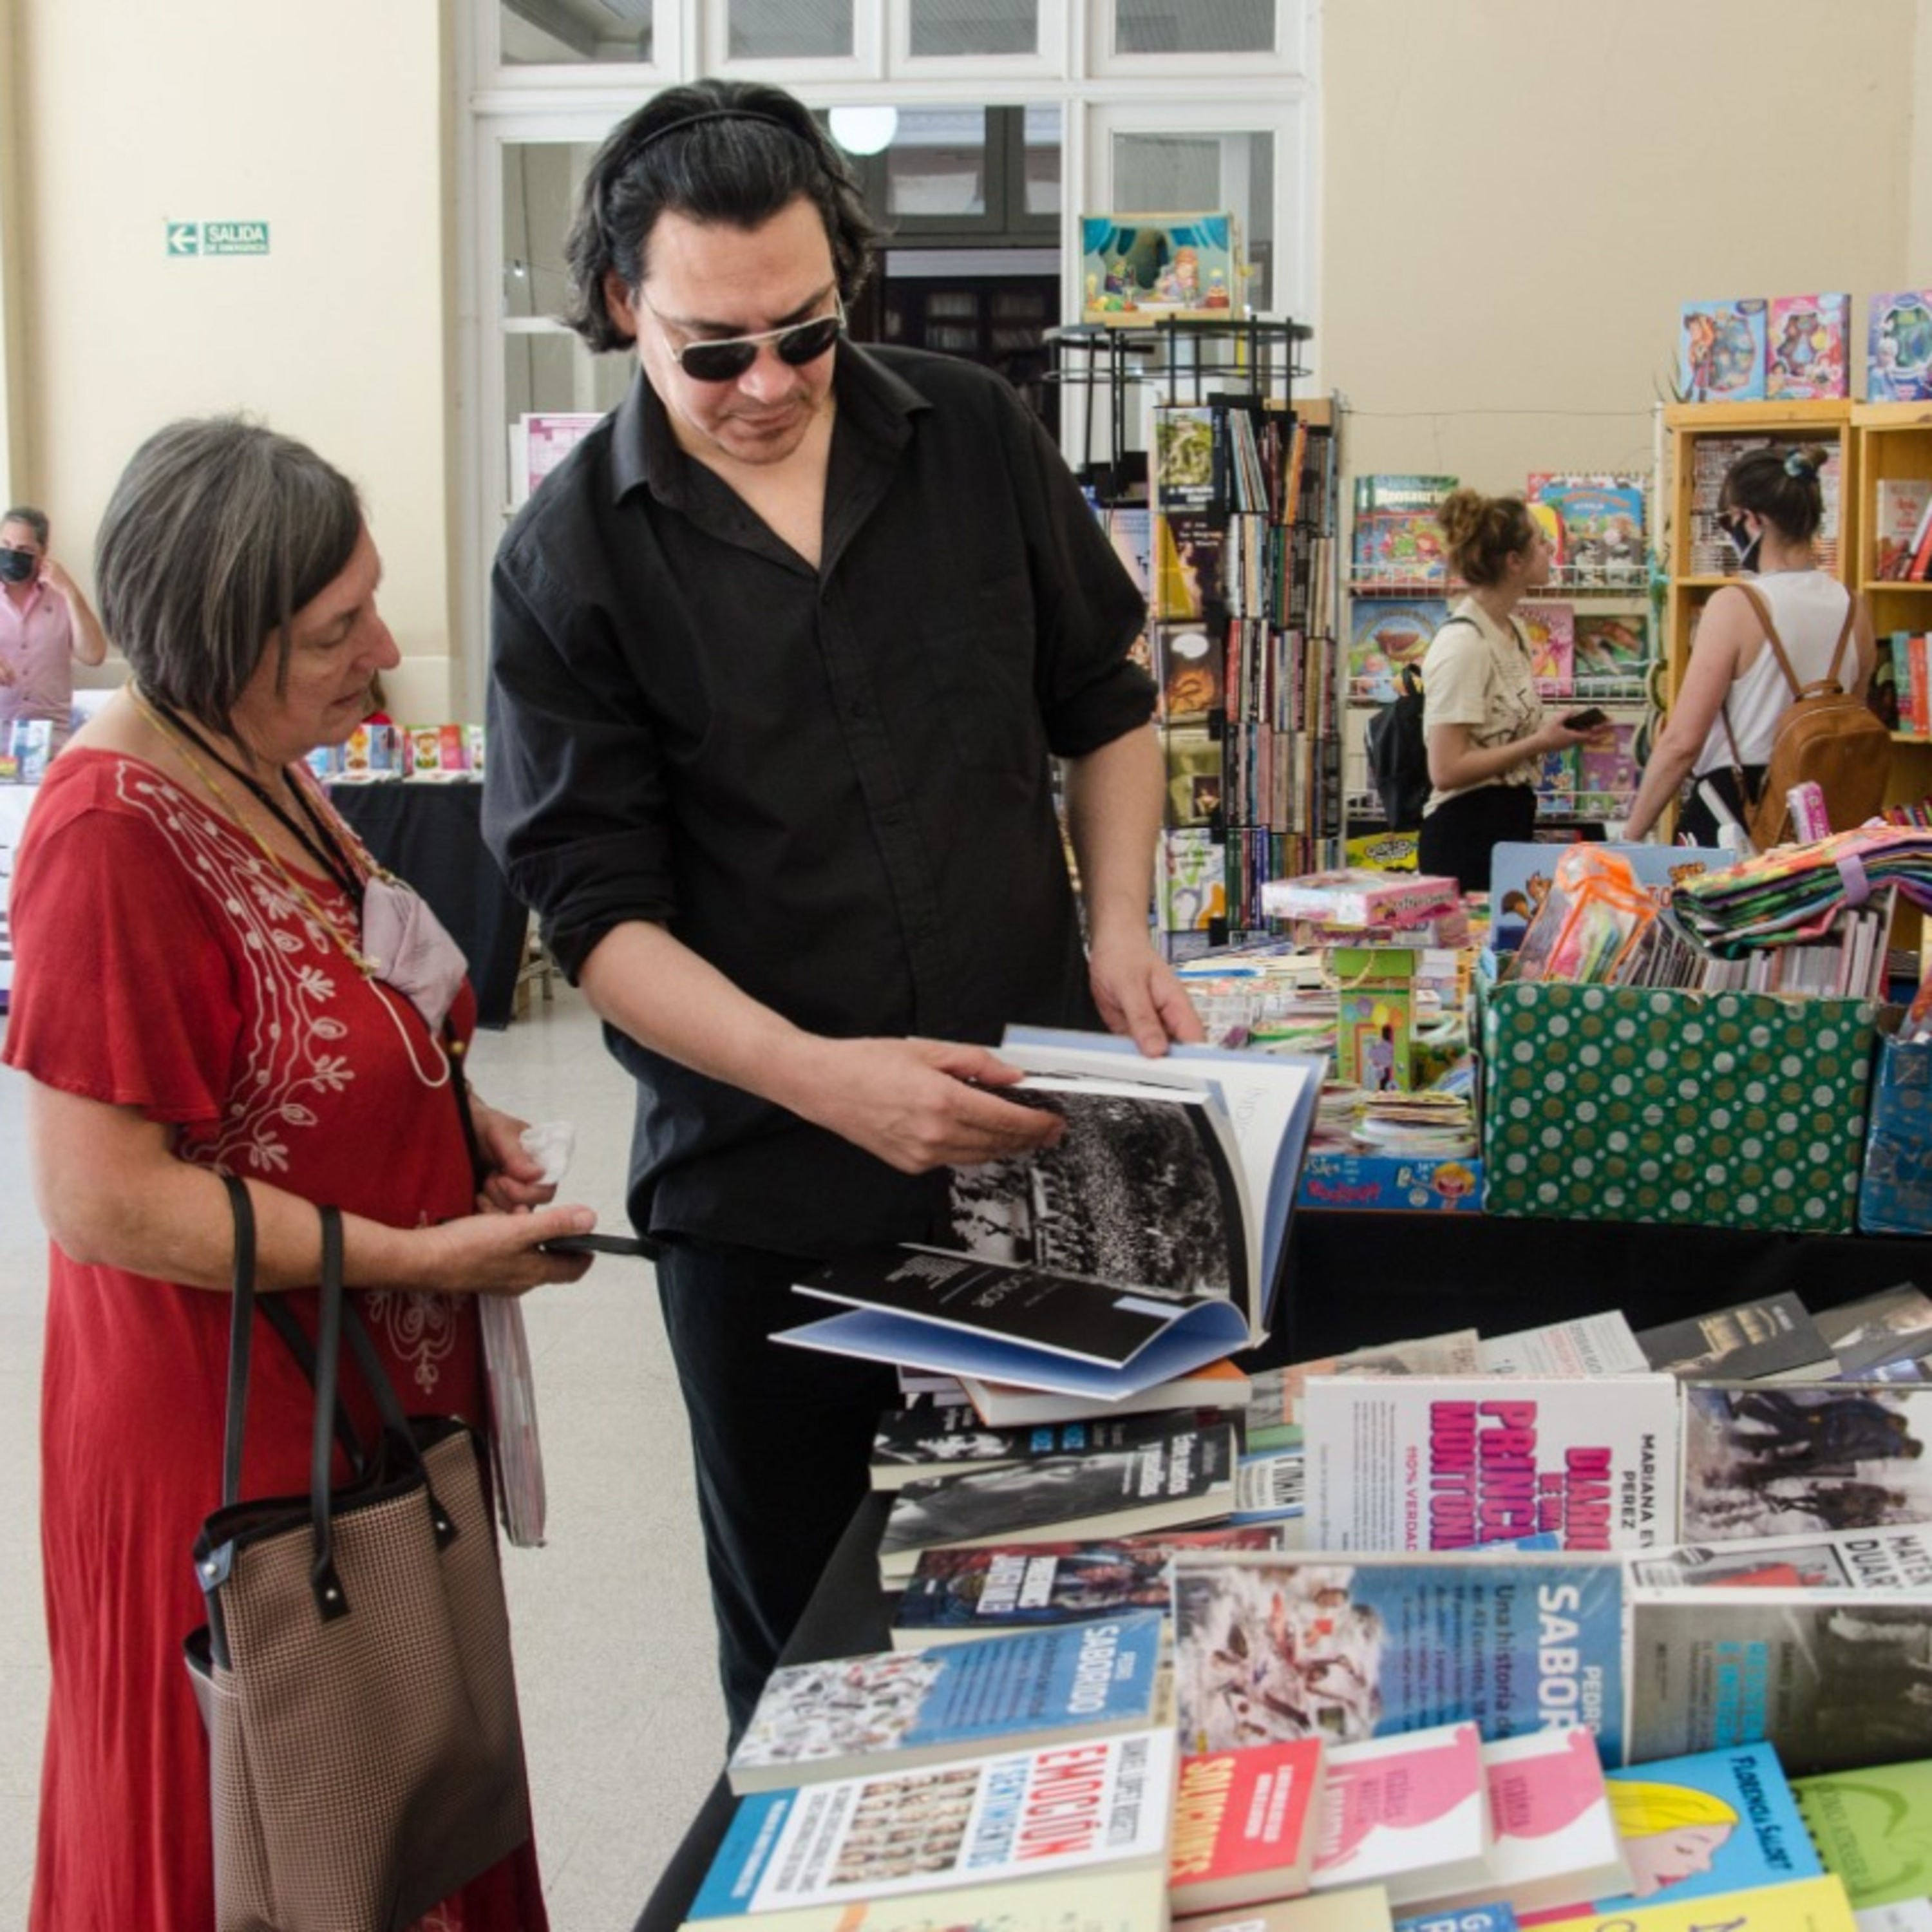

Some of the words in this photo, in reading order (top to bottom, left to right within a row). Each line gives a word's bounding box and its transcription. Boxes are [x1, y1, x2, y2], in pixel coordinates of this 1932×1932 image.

[209, 225, 263, 242] SALIDA
[1539, 1473, 1563, 1495] DE
[1621, 1470, 1636, 1529] PEREZ
[1640, 1434, 1656, 1522] MARIANA
[1844, 1539, 1904, 1589] DUAR
[1495, 1584, 1515, 1627] Una
[1066, 1624, 1121, 1714] SABORIDO
[1495, 1631, 1517, 1712] historia
[1015, 1743, 1108, 1862] EMOCIÓN
